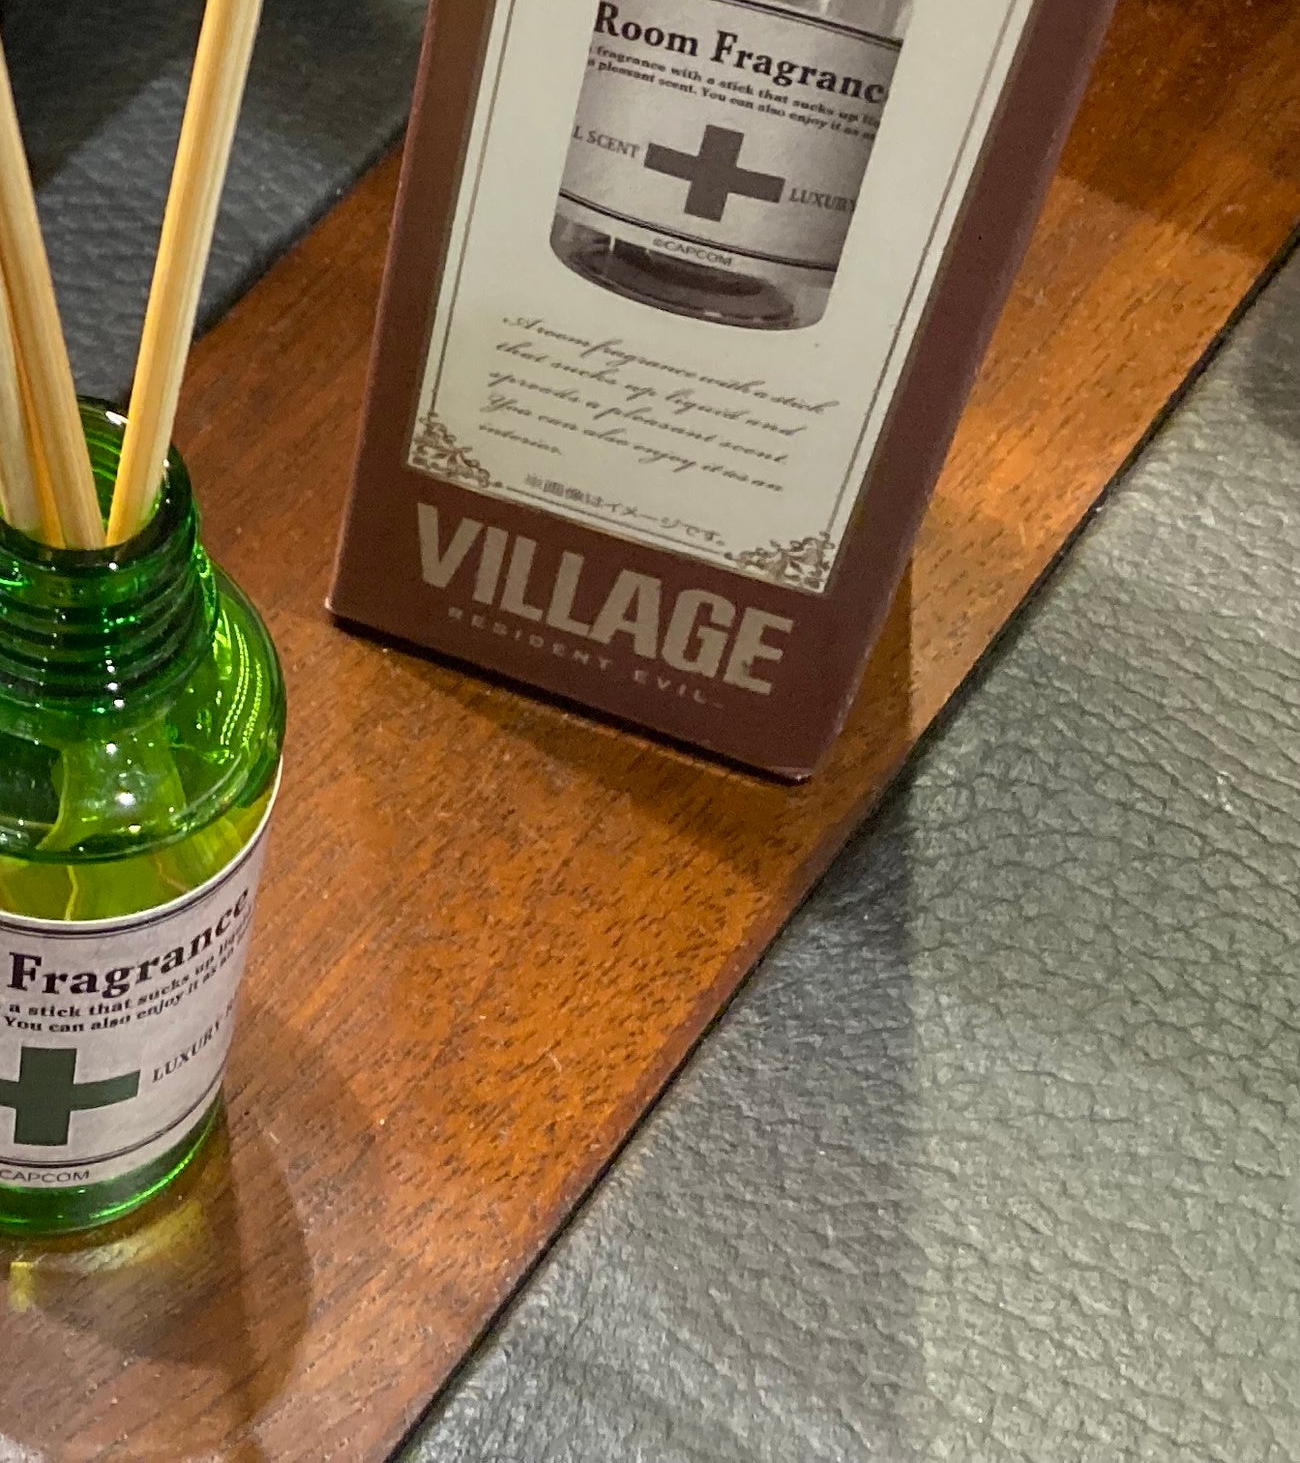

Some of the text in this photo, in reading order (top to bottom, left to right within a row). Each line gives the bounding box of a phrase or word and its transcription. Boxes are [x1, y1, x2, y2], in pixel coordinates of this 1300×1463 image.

[594, 0, 699, 57] Room
[597, 46, 666, 72] fragrance
[671, 66, 703, 83] with
[718, 80, 754, 96] stick
[758, 89, 789, 105] that
[792, 99, 834, 116] sucks
[598, 60, 656, 83] pleasant
[701, 87, 727, 103] You
[729, 96, 754, 110] can
[757, 103, 786, 118] also
[789, 111, 829, 131] enjoy
[586, 130, 640, 158] SCENT
[580, 338, 698, 378] fragrance
[417, 501, 795, 695] VILLAGE
[634, 668, 708, 706] EVIL
[6, 888, 249, 999] Fragrance
[3, 1015, 43, 1032] You
[48, 1022, 85, 1034] can
[90, 1013, 131, 1031] also
[136, 989, 185, 1020] enjoy
[9, 1003, 21, 1014] a
[28, 1005, 81, 1018] stick
[88, 997, 132, 1017] that
[137, 973, 190, 1005] sucks
